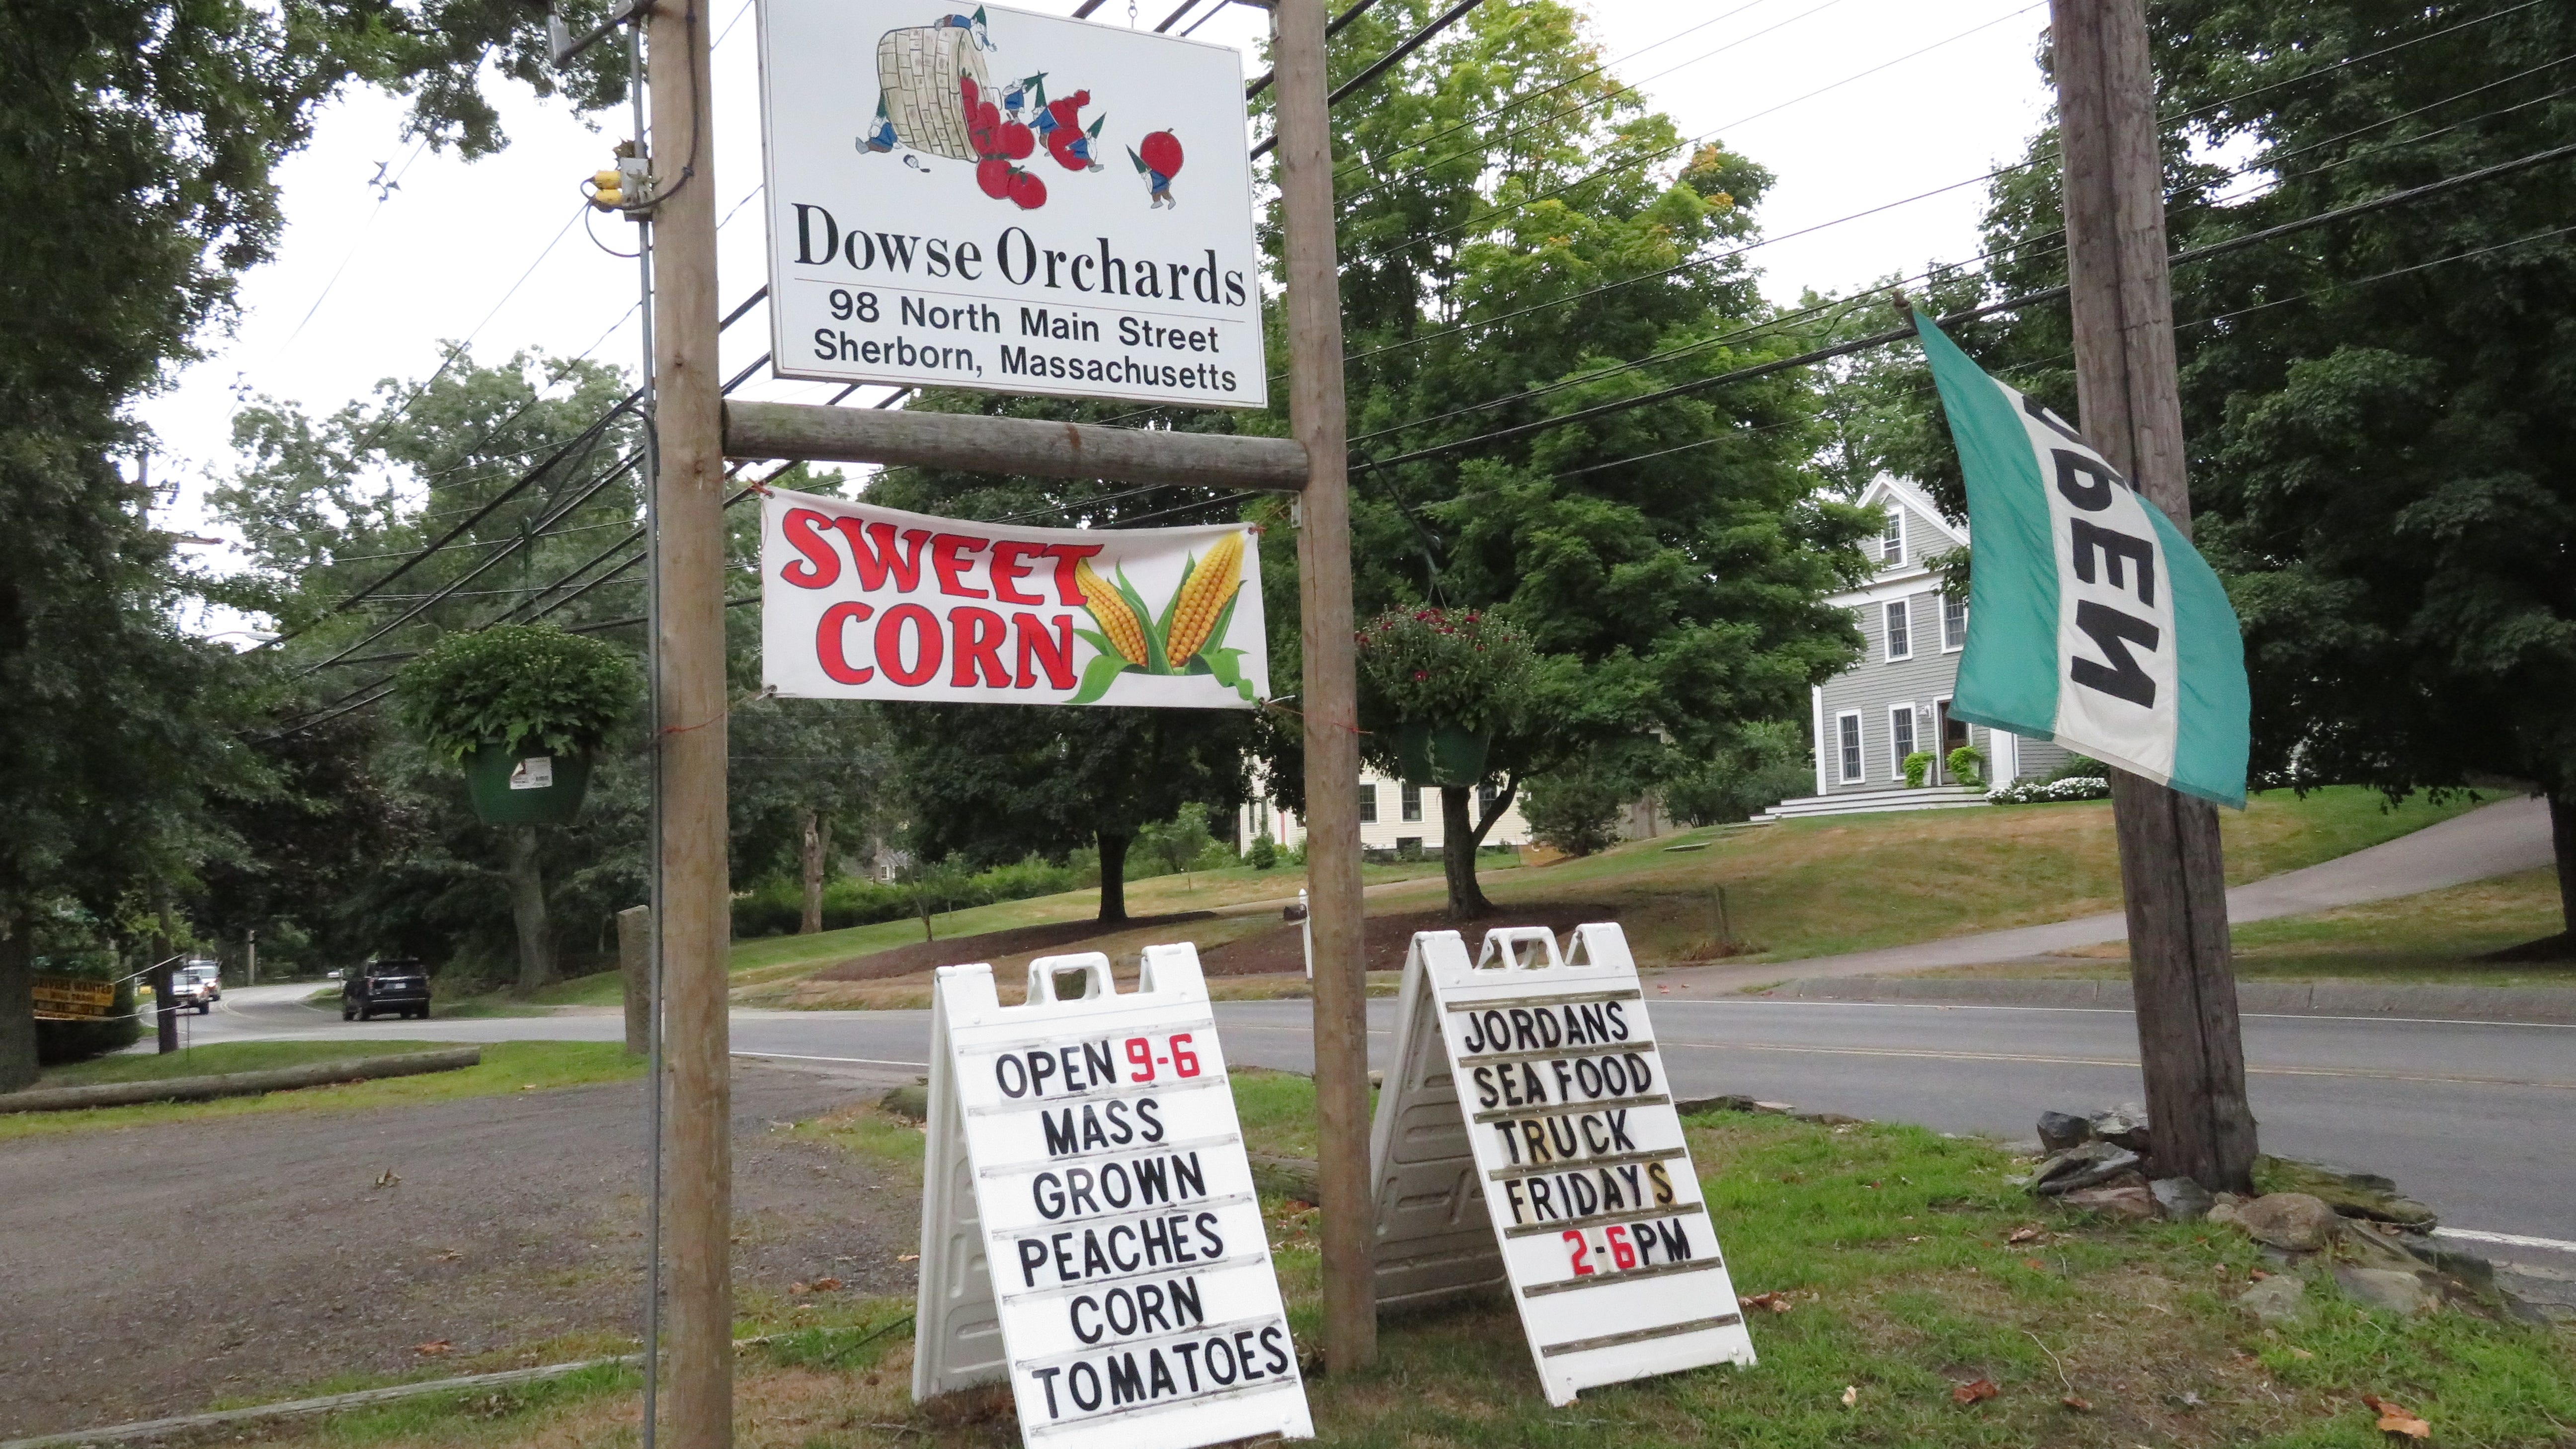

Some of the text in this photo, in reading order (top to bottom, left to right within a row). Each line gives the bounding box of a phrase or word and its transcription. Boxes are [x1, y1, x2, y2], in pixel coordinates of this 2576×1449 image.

[792, 202, 1246, 307] Dowse Orchards
[829, 290, 1219, 353] 98 North Main Street
[814, 328, 1236, 392] Sherborn, Massachusetts
[780, 508, 1104, 607] SWEET
[816, 601, 1078, 690] CORN
[1465, 1001, 1629, 1054] JORDANS
[996, 1033, 1200, 1099] OPEN 9-6
[1042, 1098, 1164, 1156] MASS
[1494, 1109, 1636, 1164] TRUCK
[1033, 1151, 1207, 1220] GROWN
[1505, 1161, 1674, 1224] FRIDAYS
[1018, 1212, 1224, 1287] PEACHES
[1562, 1218, 1691, 1276] 2-6PM
[1070, 1276, 1204, 1344] CORN
[1032, 1326, 1288, 1419] TOMATOES
